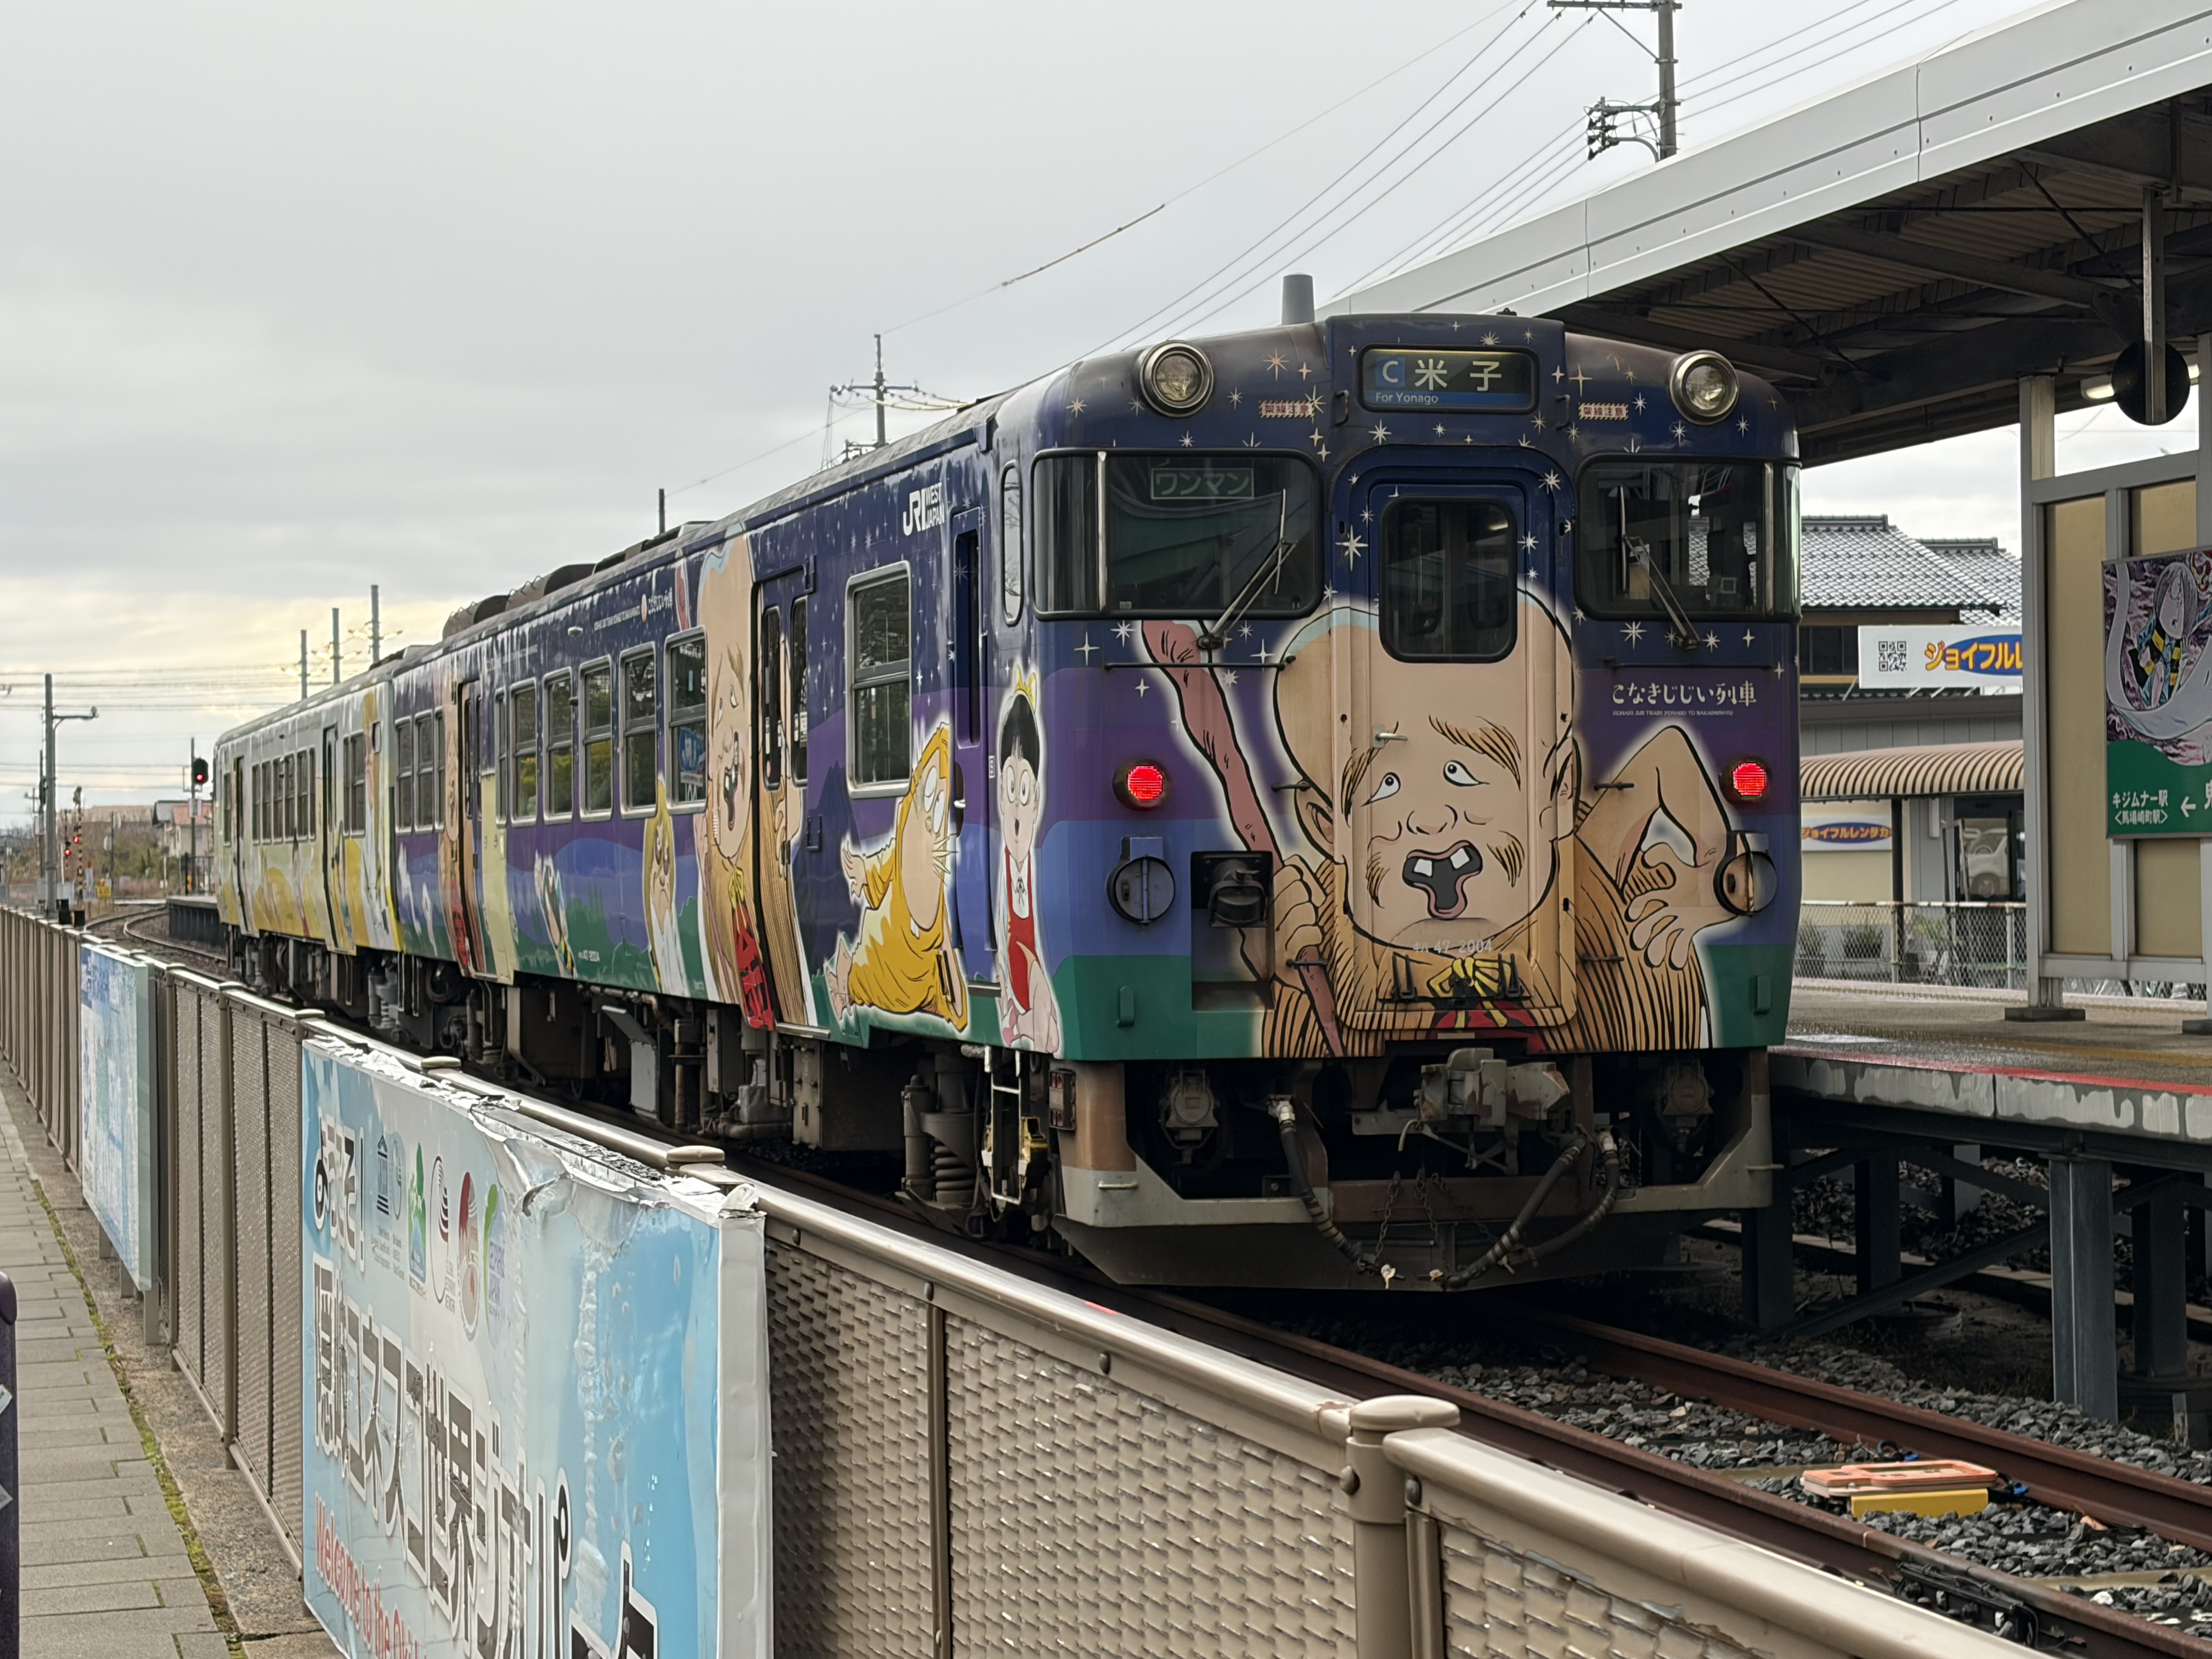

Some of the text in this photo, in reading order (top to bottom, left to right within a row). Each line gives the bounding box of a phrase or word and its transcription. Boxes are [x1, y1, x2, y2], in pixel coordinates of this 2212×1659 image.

[1382, 358, 1502, 392] C 米子
[1376, 392, 1438, 405] For Yonago
[925, 482, 942, 506] WEST
[1156, 472, 1249, 495] ワンマン
[903, 490, 921, 536] JR
[926, 503, 945, 529] JAPAN
[1612, 680, 1757, 707] こなきじじい列車
[2113, 789, 2168, 809] キジムナー駅
[1801, 826, 1892, 839] ジョイフルレンタカ
[1413, 939, 1493, 953] キハ 47 2004
[314, 1253, 657, 1659] 隠岐ユネスコ世界ジオパ
[316, 1493, 390, 1659] Welcome to the
